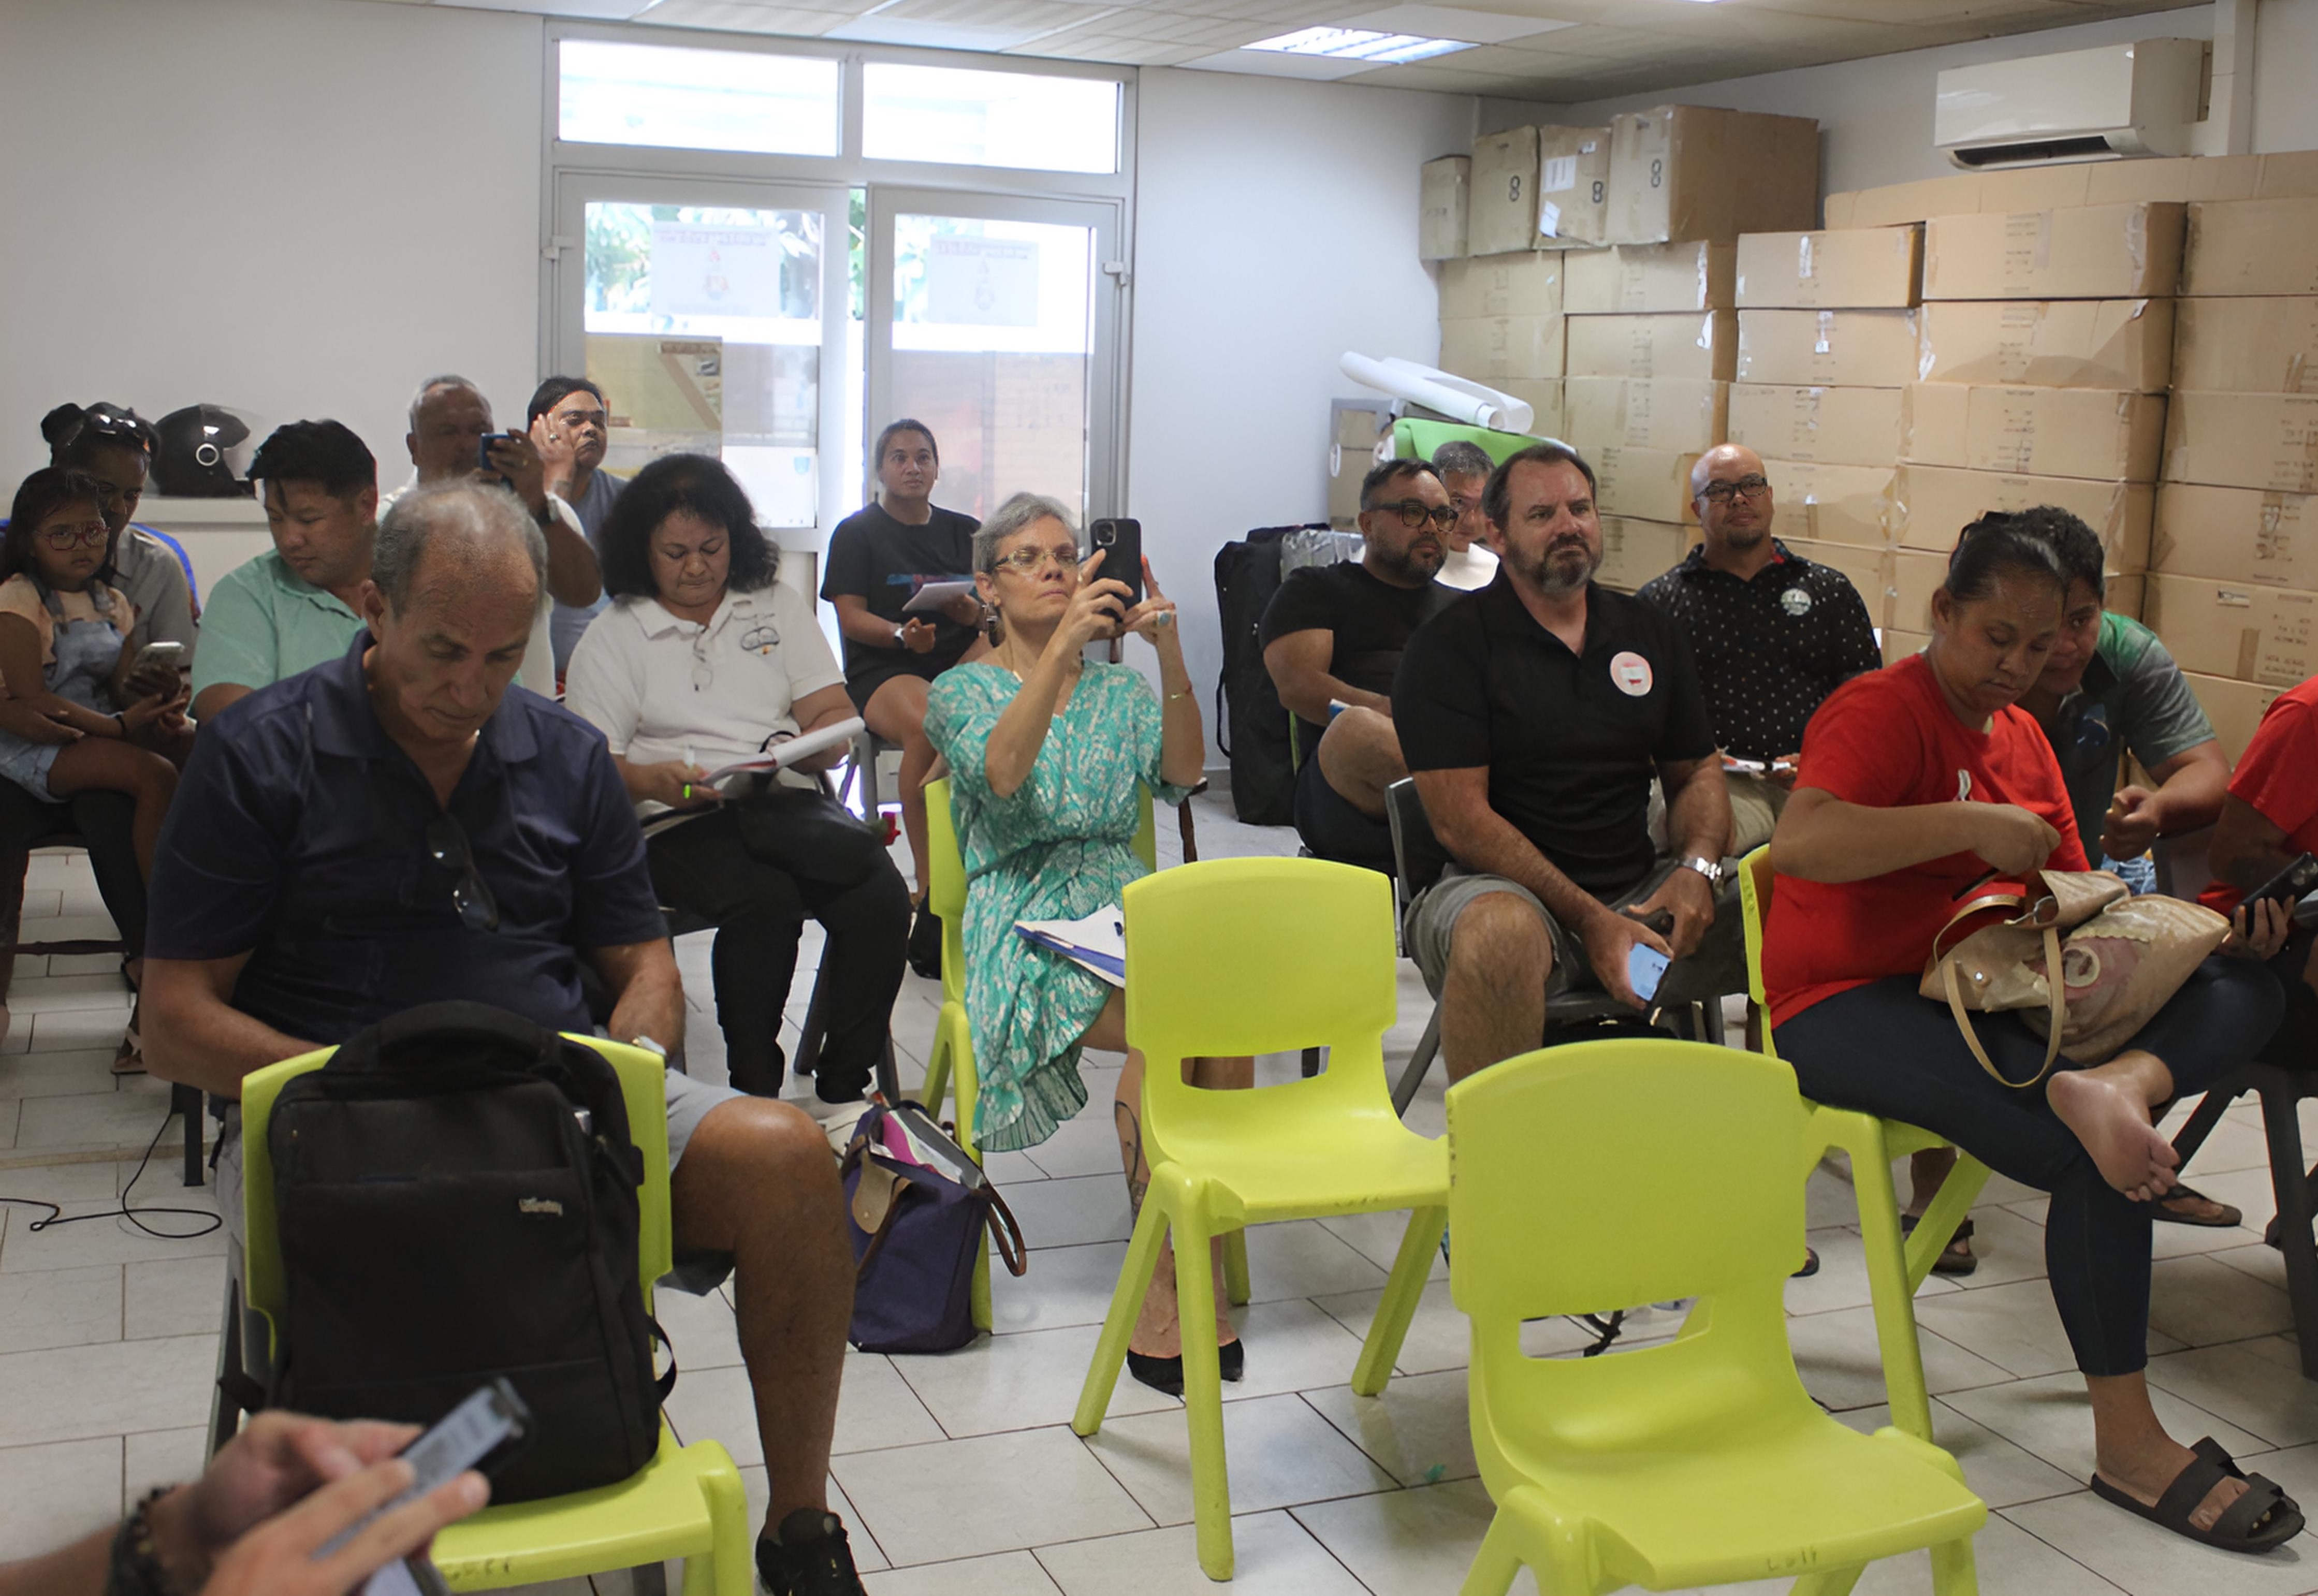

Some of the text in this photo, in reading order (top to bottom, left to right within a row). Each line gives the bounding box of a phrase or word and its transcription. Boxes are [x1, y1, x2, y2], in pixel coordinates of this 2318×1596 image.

[1651, 158, 1661, 188] 8
[1508, 175, 1520, 201] 8
[1592, 181, 1604, 203] 8
